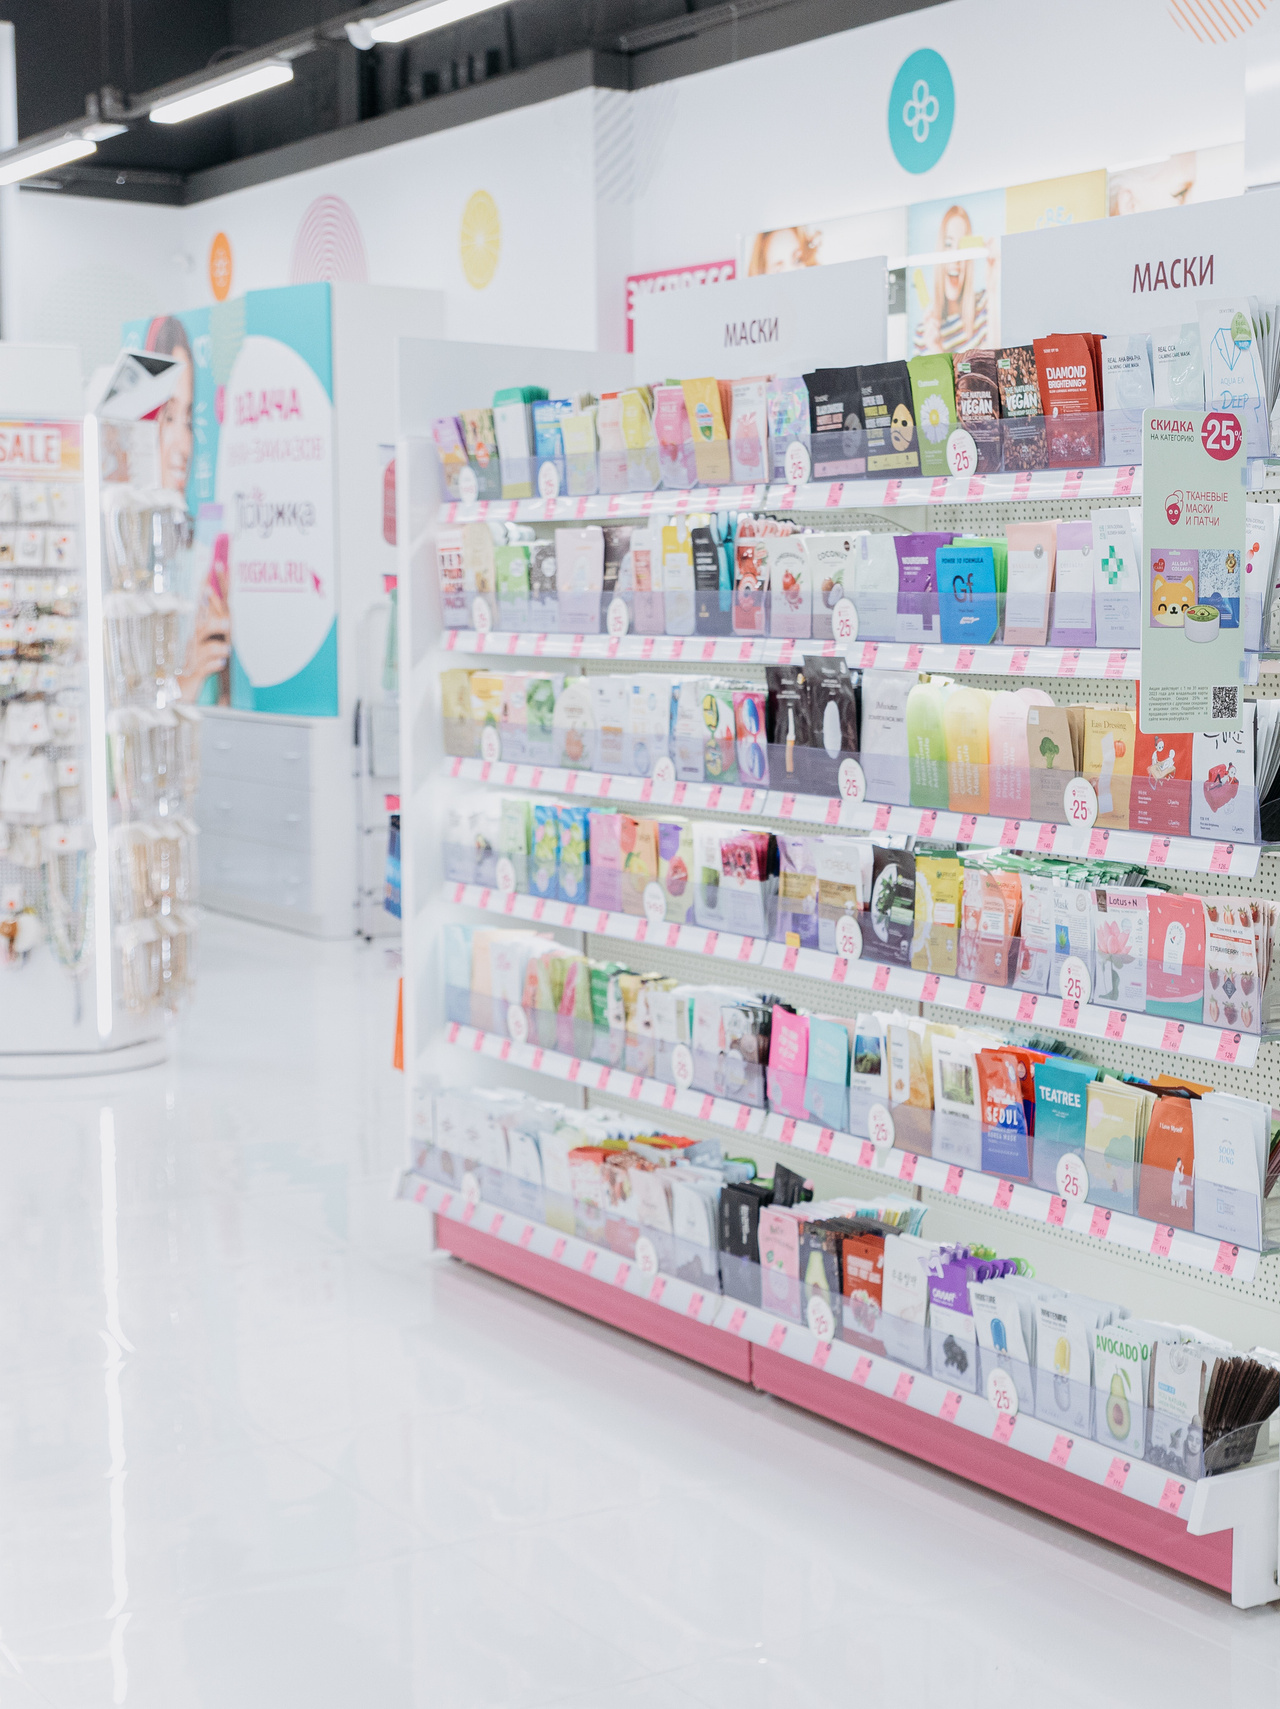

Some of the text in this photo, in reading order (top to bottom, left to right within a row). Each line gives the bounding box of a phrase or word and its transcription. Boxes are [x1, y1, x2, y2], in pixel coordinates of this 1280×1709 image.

[1132, 254, 1214, 293] МАСКИ
[724, 317, 779, 348] МАСКИ
[1046, 365, 1087, 380] DIAMOND
[1047, 379, 1081, 389] BRIGHTENING
[1220, 377, 1235, 385] AQUA
[1005, 394, 1038, 409] VEGAN
[1220, 390, 1249, 410] DEEP
[961, 400, 993, 415] VEGAN
[1150, 419, 1194, 433] СКИДКА
[1160, 434, 1195, 443] КАТЕГОРИЮ
[1201, 418, 1242, 451] -25%
[1185, 491, 1229, 502] ТКАНЕВЫЕ
[1185, 503, 1214, 514] МАСКИ
[1186, 516, 1220, 526] И ПАТЧИ
[1091, 720, 1127, 731] Easy Dressing
[1109, 896, 1127, 906] Lotus
[1038, 1085, 1081, 1109] TEATREE
[986, 1106, 1019, 1126] SEOUL
[1218, 1144, 1235, 1157] SOON
[1218, 1154, 1235, 1167] JUNG
[1096, 1334, 1139, 1363] AVOCADO
